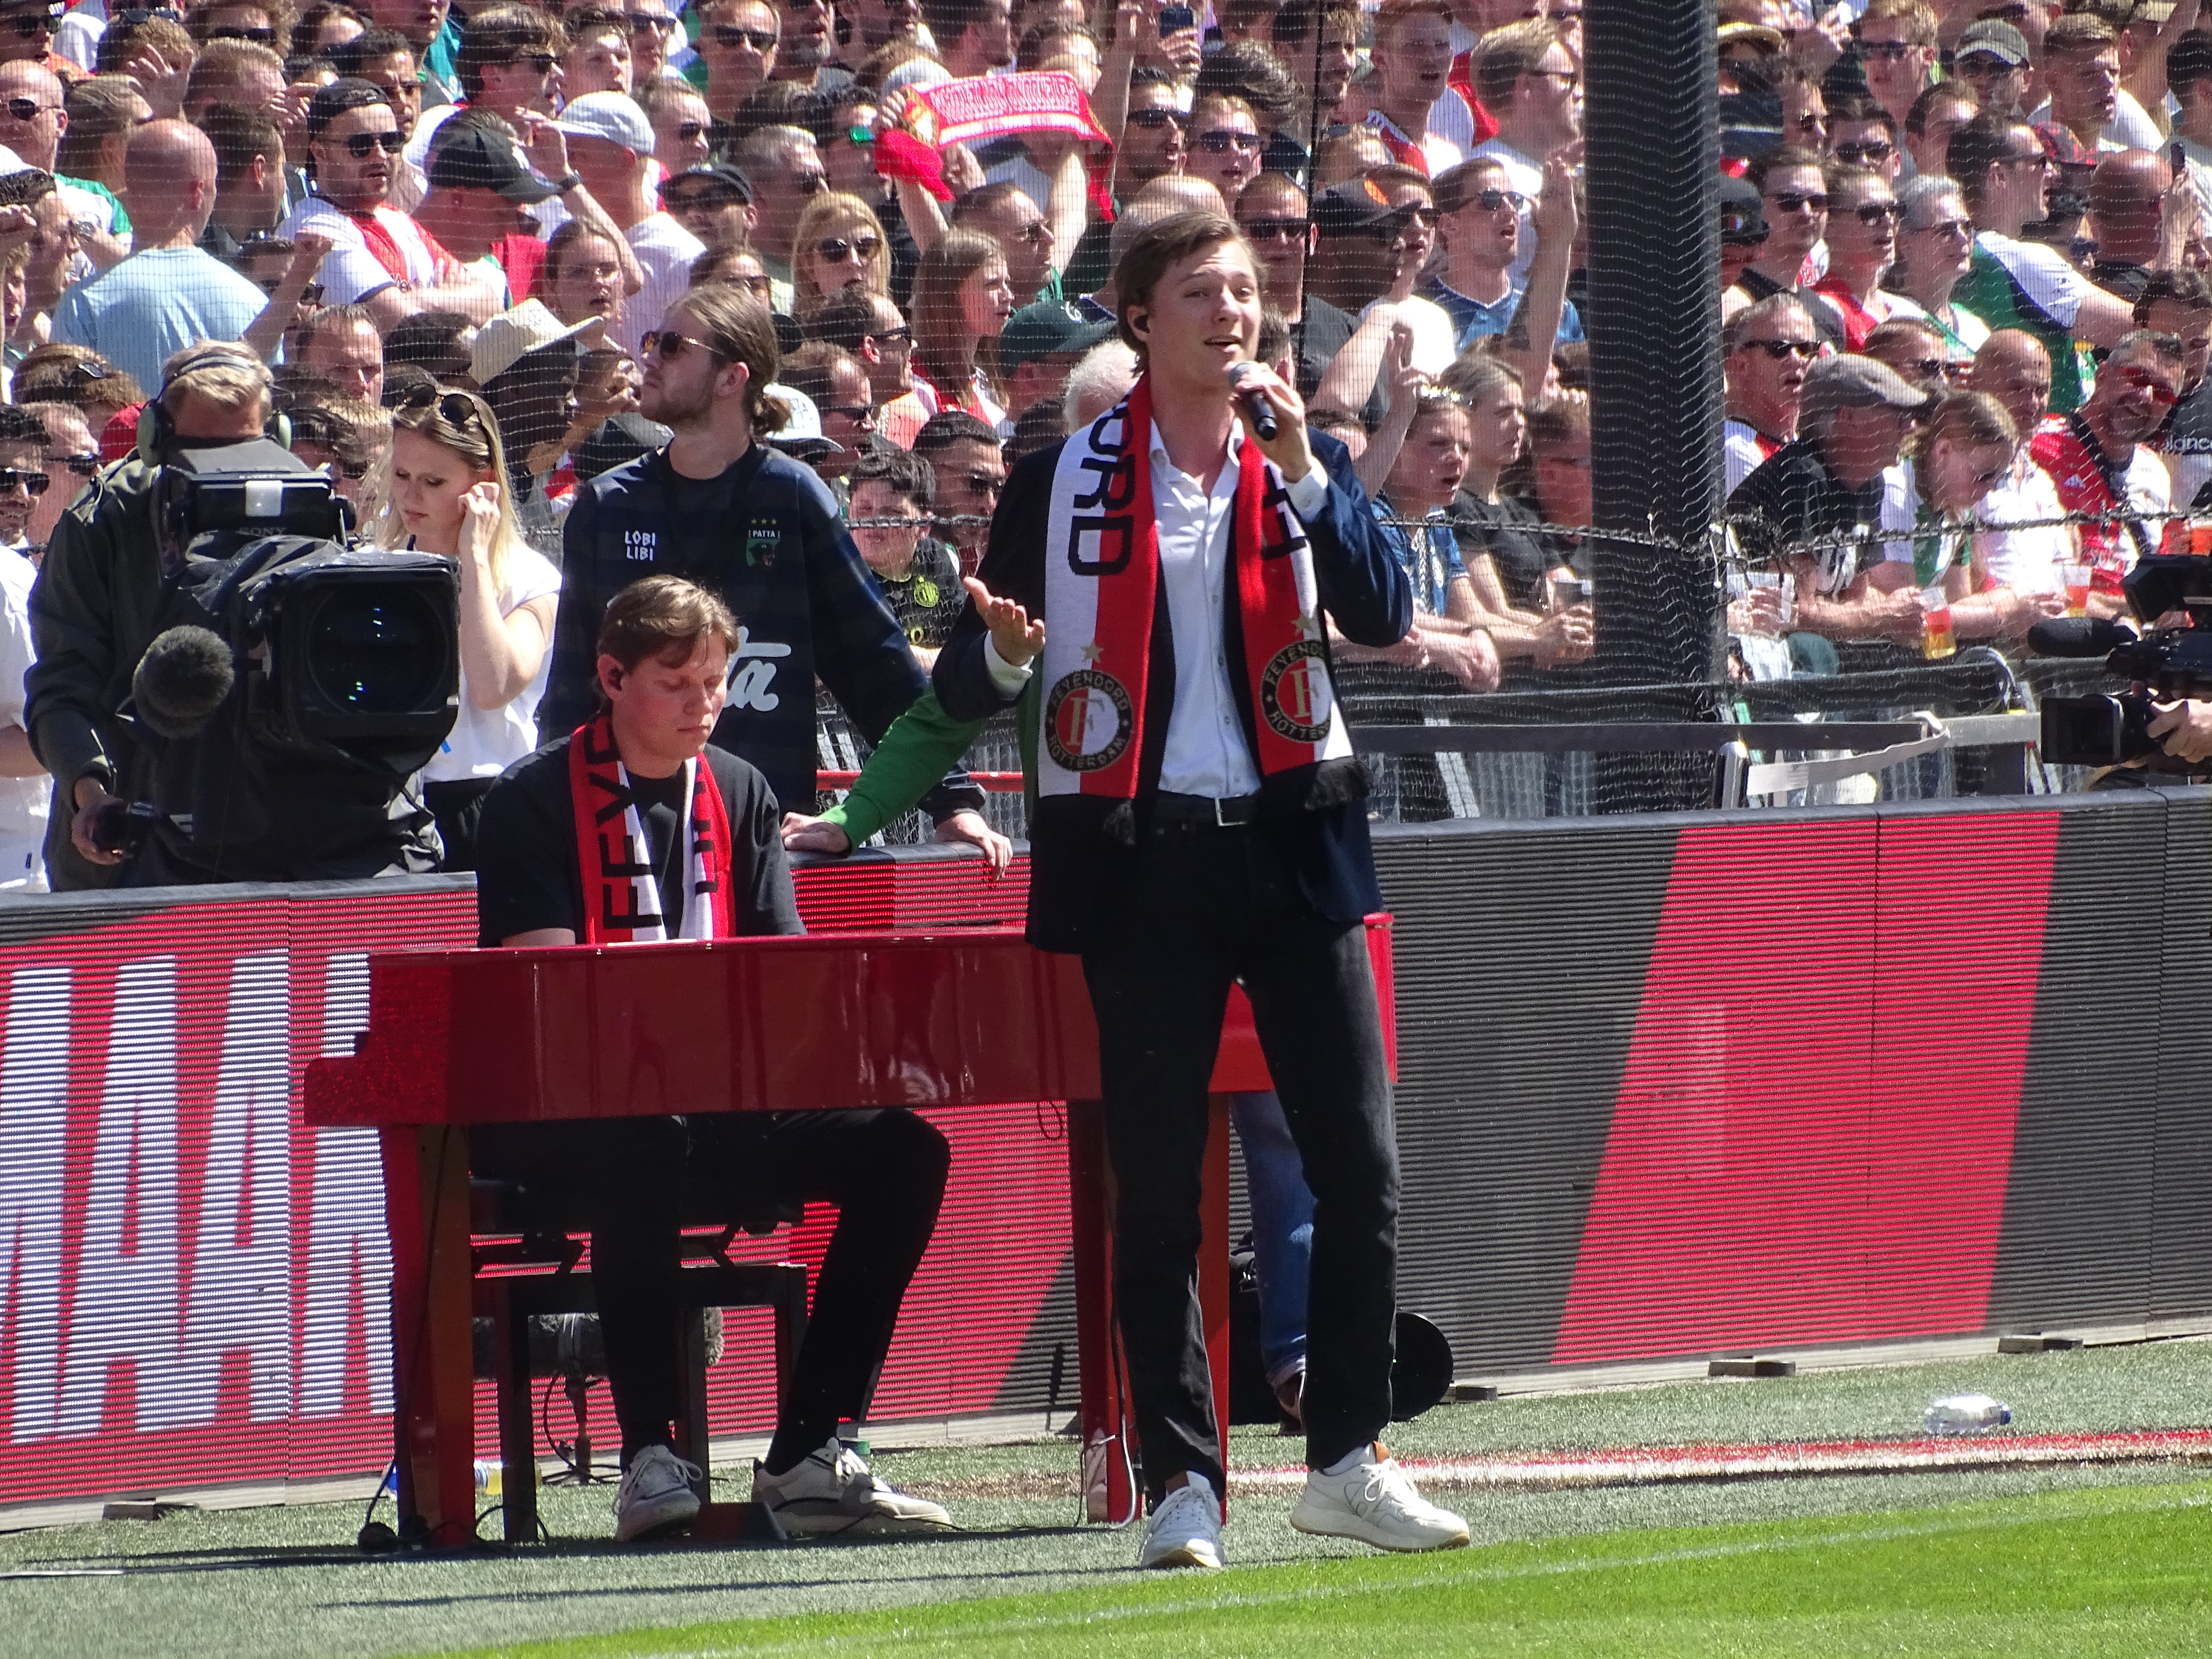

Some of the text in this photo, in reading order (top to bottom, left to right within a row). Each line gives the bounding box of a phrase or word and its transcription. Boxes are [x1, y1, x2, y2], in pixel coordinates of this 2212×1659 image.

[625, 530, 657, 547] LOBI
[752, 530, 776, 538] PATTA
[626, 546, 655, 562] LIBI
